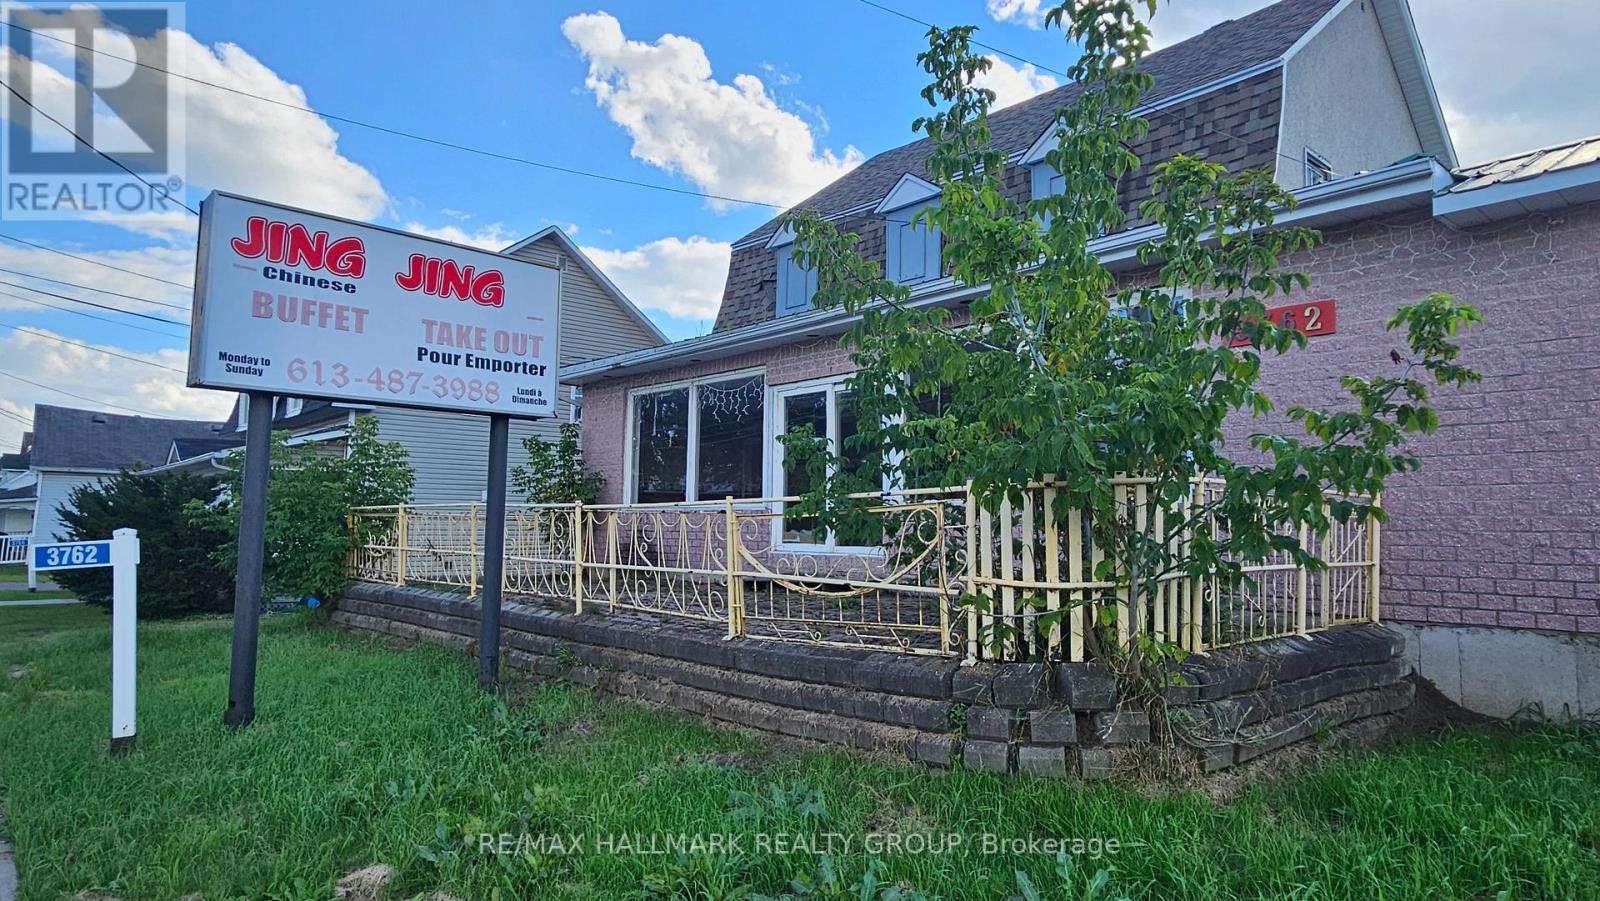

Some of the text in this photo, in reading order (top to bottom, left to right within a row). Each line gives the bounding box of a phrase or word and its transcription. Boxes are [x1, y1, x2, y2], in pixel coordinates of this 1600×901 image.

[231, 216, 505, 307] JING JING
[262, 266, 357, 294] Chinese
[251, 290, 369, 334] BUFFET
[421, 318, 545, 358] TAKE OUT
[218, 351, 271, 367] Monday to
[225, 363, 264, 377] Sunday
[417, 346, 547, 377] Pour Emporter
[287, 357, 501, 404] 613-487-3988
[516, 387, 537, 397] Lundi
[511, 395, 548, 406] Dimanche
[46, 545, 98, 566] 3762
